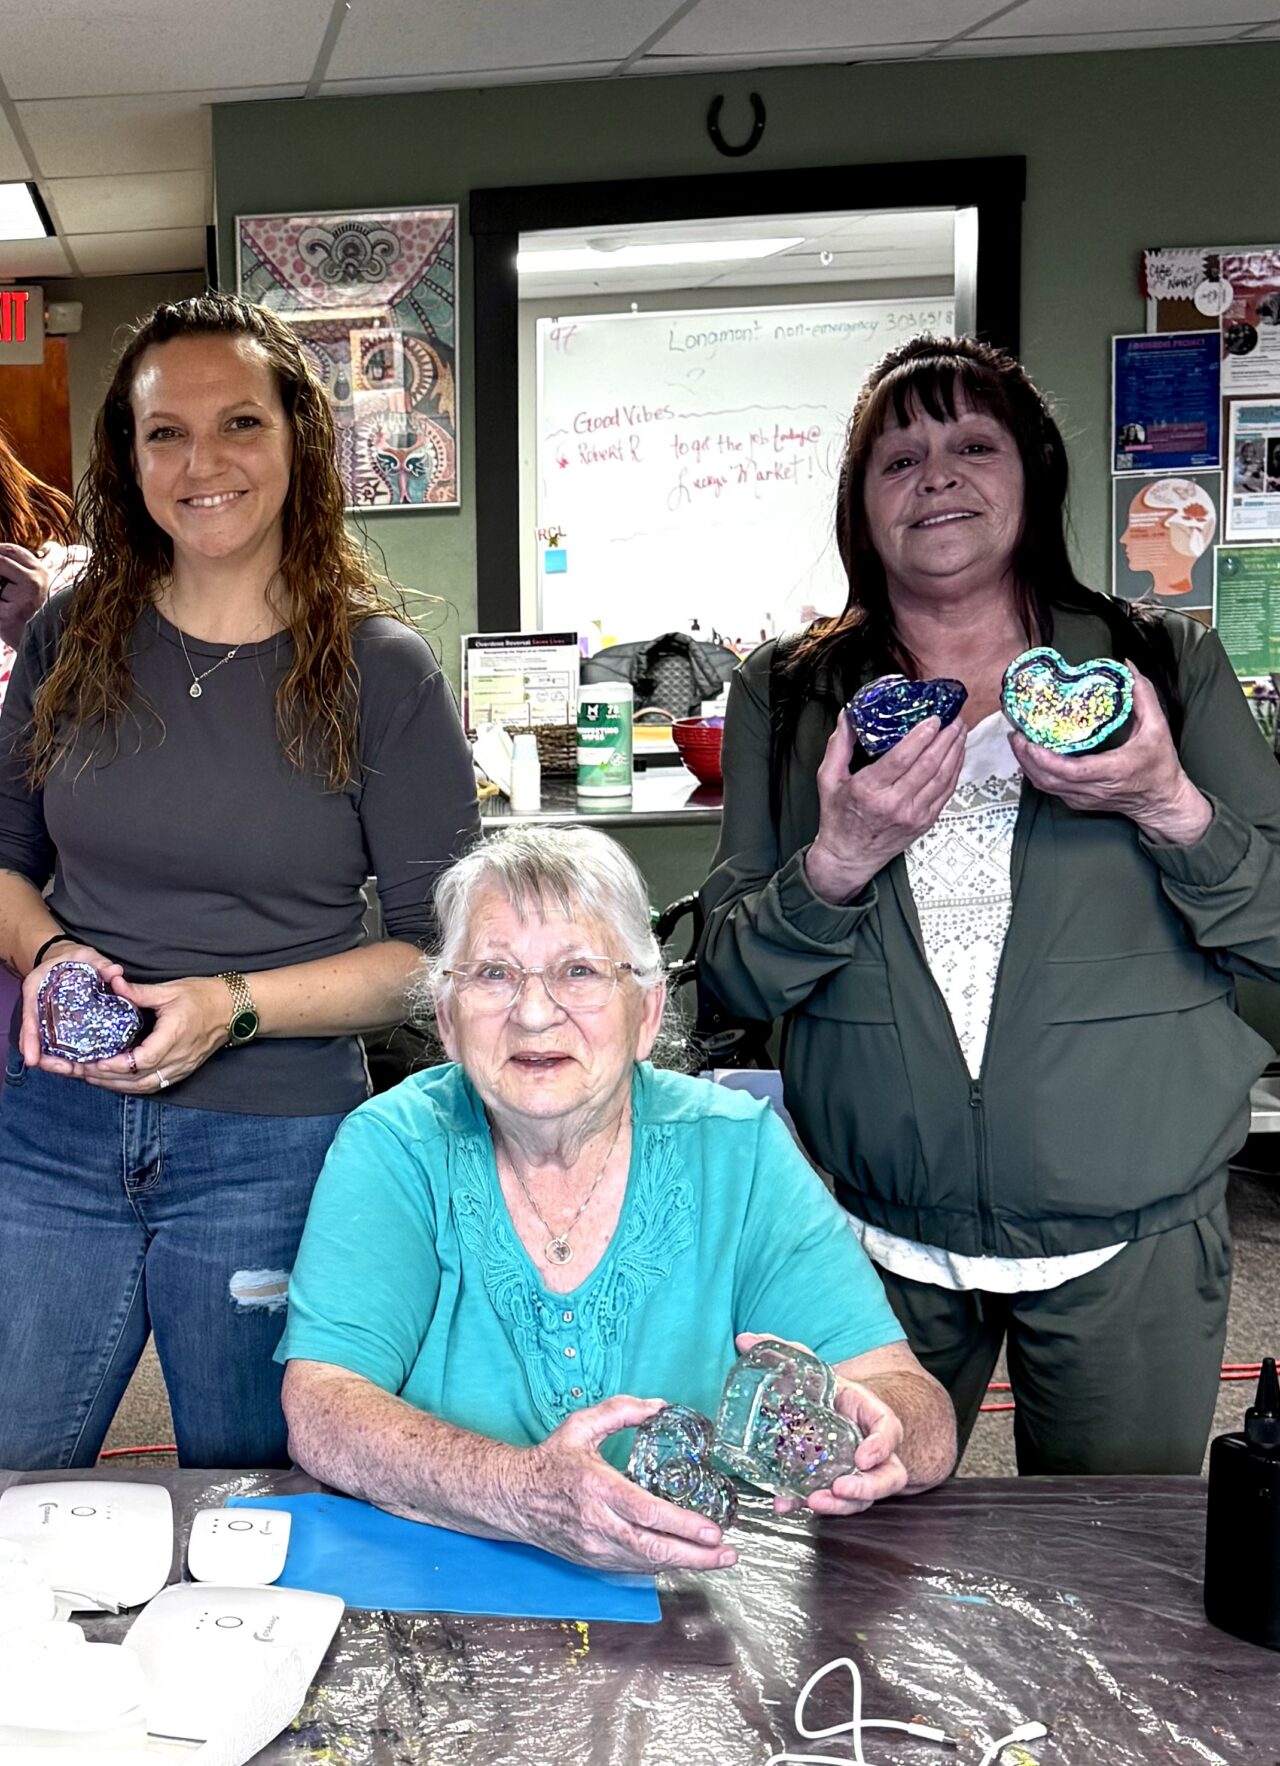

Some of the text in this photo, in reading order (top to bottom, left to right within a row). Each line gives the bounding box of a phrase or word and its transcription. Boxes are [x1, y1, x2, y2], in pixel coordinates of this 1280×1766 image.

[573, 404, 675, 434] Good Vibes
[717, 434, 743, 454] the
